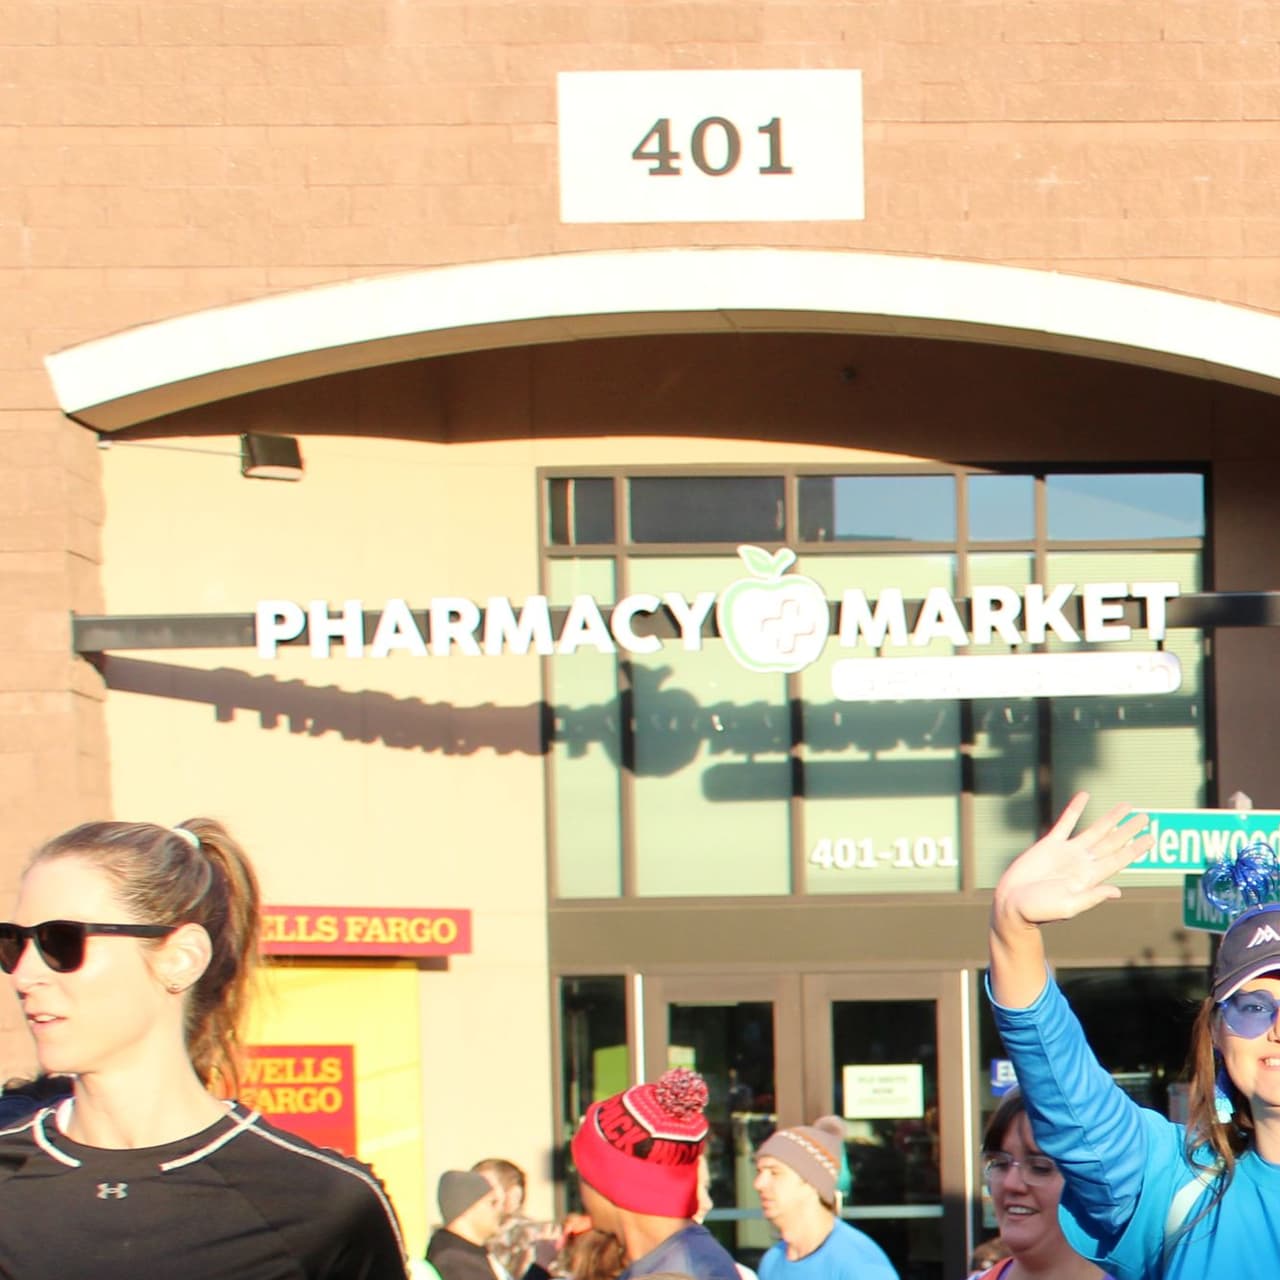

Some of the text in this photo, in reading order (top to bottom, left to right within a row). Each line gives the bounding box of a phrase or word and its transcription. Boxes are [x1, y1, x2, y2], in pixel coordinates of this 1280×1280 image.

[631, 117, 794, 176] 401
[256, 581, 1180, 660] PHARMACY MARKET
[811, 837, 958, 870] 401-101
[261, 914, 458, 945] ELLS FARGO
